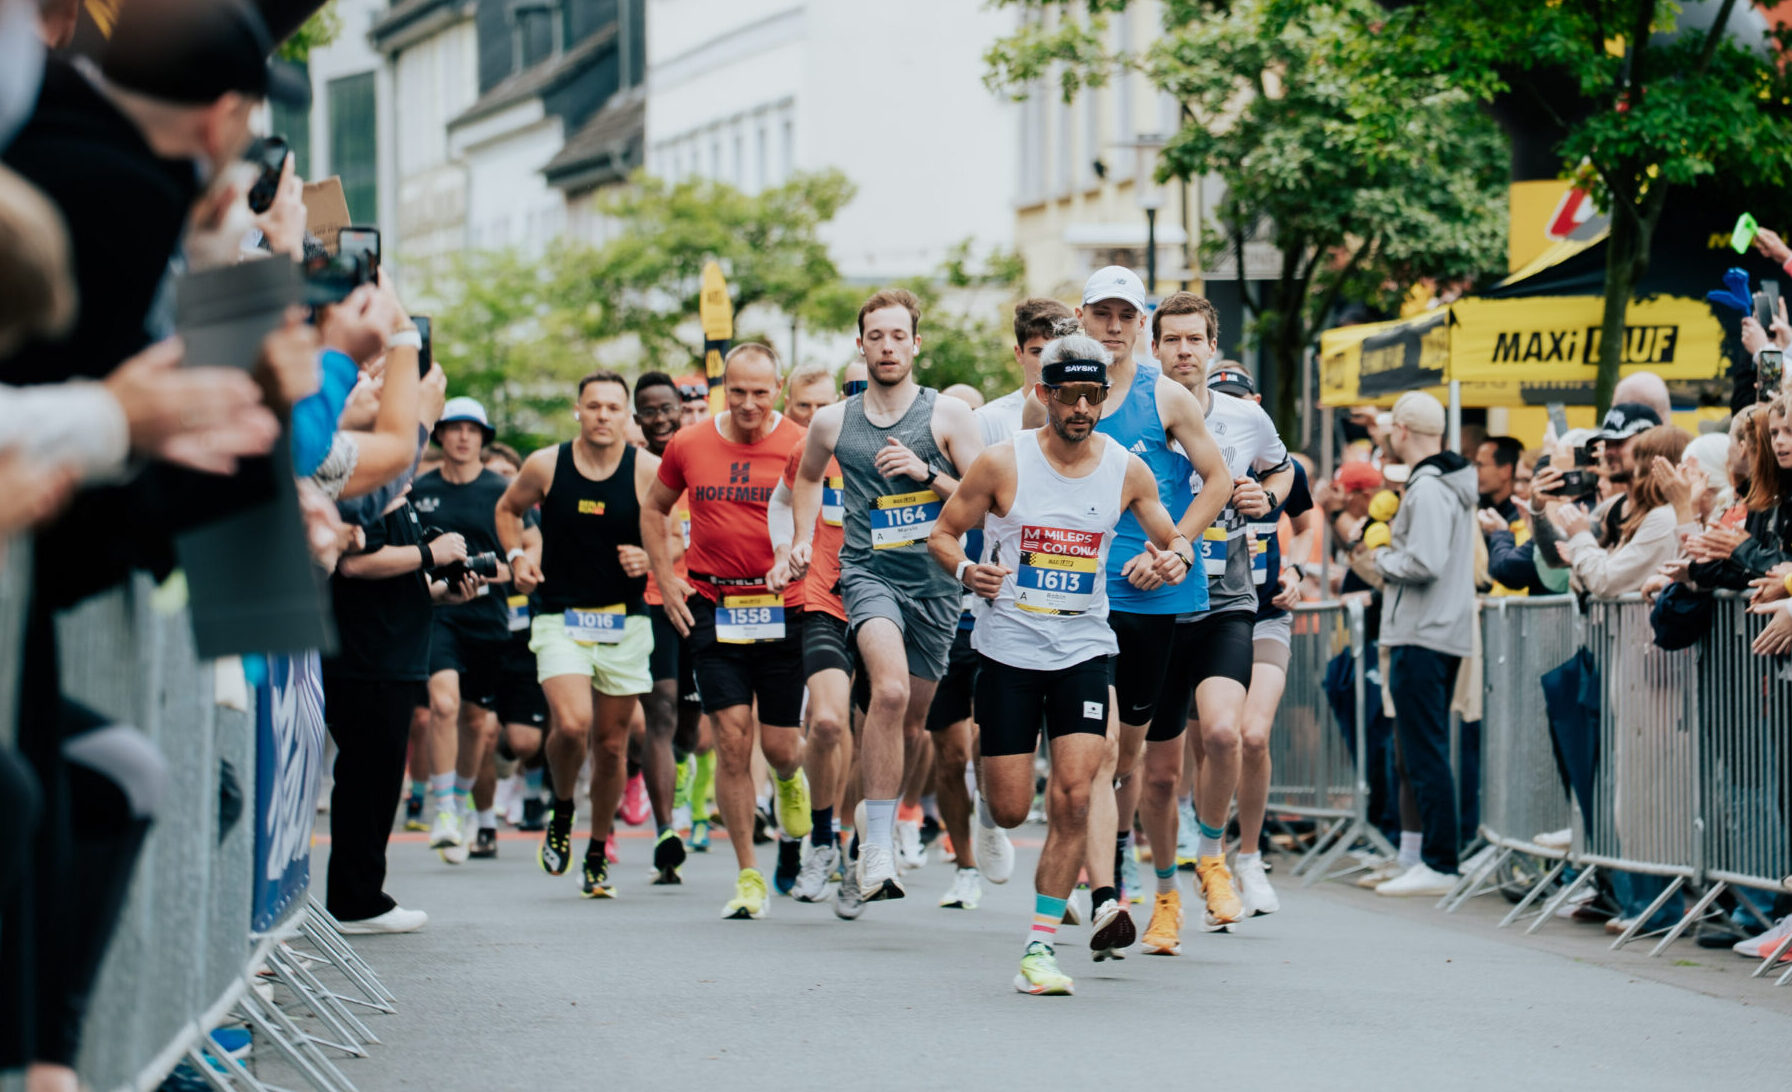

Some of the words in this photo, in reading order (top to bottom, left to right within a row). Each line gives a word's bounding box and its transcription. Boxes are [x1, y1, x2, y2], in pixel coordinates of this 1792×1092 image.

[1492, 331, 1577, 363] MAXi
[885, 506, 926, 526] 1164
[877, 532, 883, 540] A
[1044, 529, 1093, 543] MILERS
[1036, 569, 1080, 592] 1613
[1020, 592, 1027, 600] A
[578, 612, 614, 628] 1016
[728, 608, 771, 624] 1558
